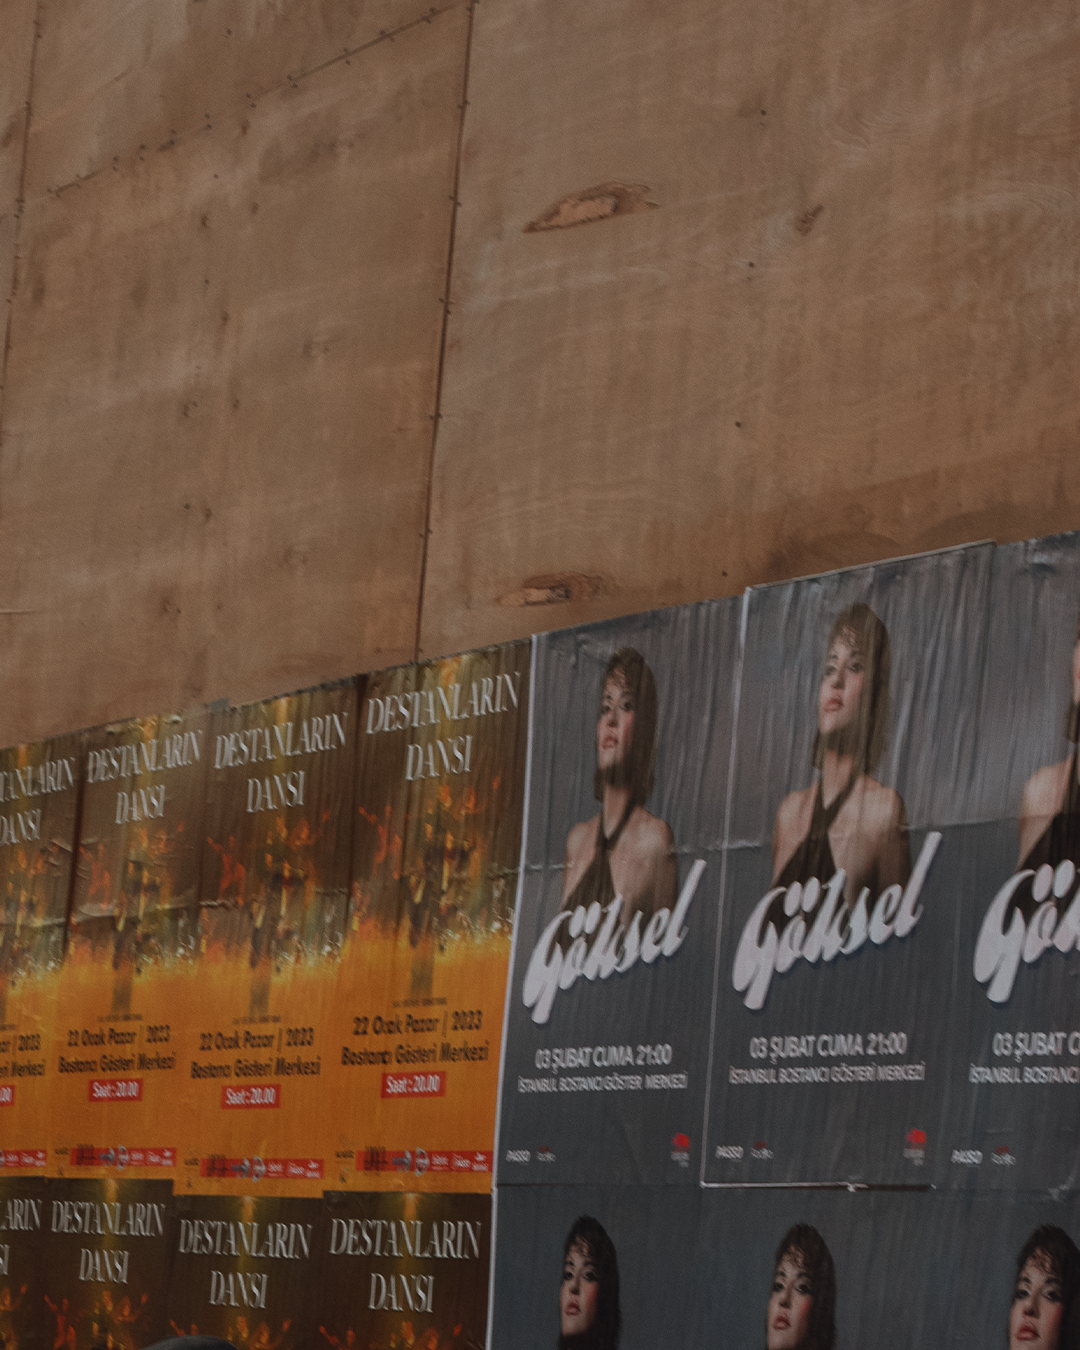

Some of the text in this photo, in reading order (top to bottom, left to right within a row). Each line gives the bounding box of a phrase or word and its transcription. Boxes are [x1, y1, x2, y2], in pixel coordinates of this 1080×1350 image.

[365, 671, 520, 734] DESTANLARIN
[87, 730, 203, 783] DESTANLARIN
[214, 711, 348, 769] DESTANLARIN
[405, 734, 473, 781] DANSI
[115, 785, 165, 825] DANSI
[246, 770, 305, 813] DANSI
[732, 831, 943, 1010] Göksel
[522, 859, 707, 1024] Göksel
[214, 1030, 241, 1050] Ocak
[243, 1030, 274, 1049] Pazar
[286, 1026, 314, 1047] 2023
[353, 1009, 483, 1035] 22 Ocak Pazar 2023
[394, 1042, 437, 1064] Gösteri
[440, 1039, 490, 1062] Merkezi
[535, 1044, 673, 1074] 03 ŞUBAT CUMA 21:00
[750, 1032, 908, 1065] 03 ŞUBAT CUMA 21:00
[992, 1032, 1013, 1057] 03
[1014, 1032, 1067, 1063] ŞUBAT
[518, 1075, 558, 1093] İSTANBUL
[559, 1077, 602, 1092] BOSTANCI
[729, 1065, 778, 1084] İSTANBUL
[779, 1065, 830, 1083] BOSTANCI
[969, 1062, 1022, 1084] İSTANBUL
[50, 1200, 166, 1237] DESTANLARIN
[179, 1219, 313, 1259] DESTANLARIN
[329, 1218, 483, 1260] DESTANLARIN
[78, 1248, 130, 1284] DANSI
[209, 1270, 268, 1309] DANSI
[368, 1272, 435, 1313] DANSI
